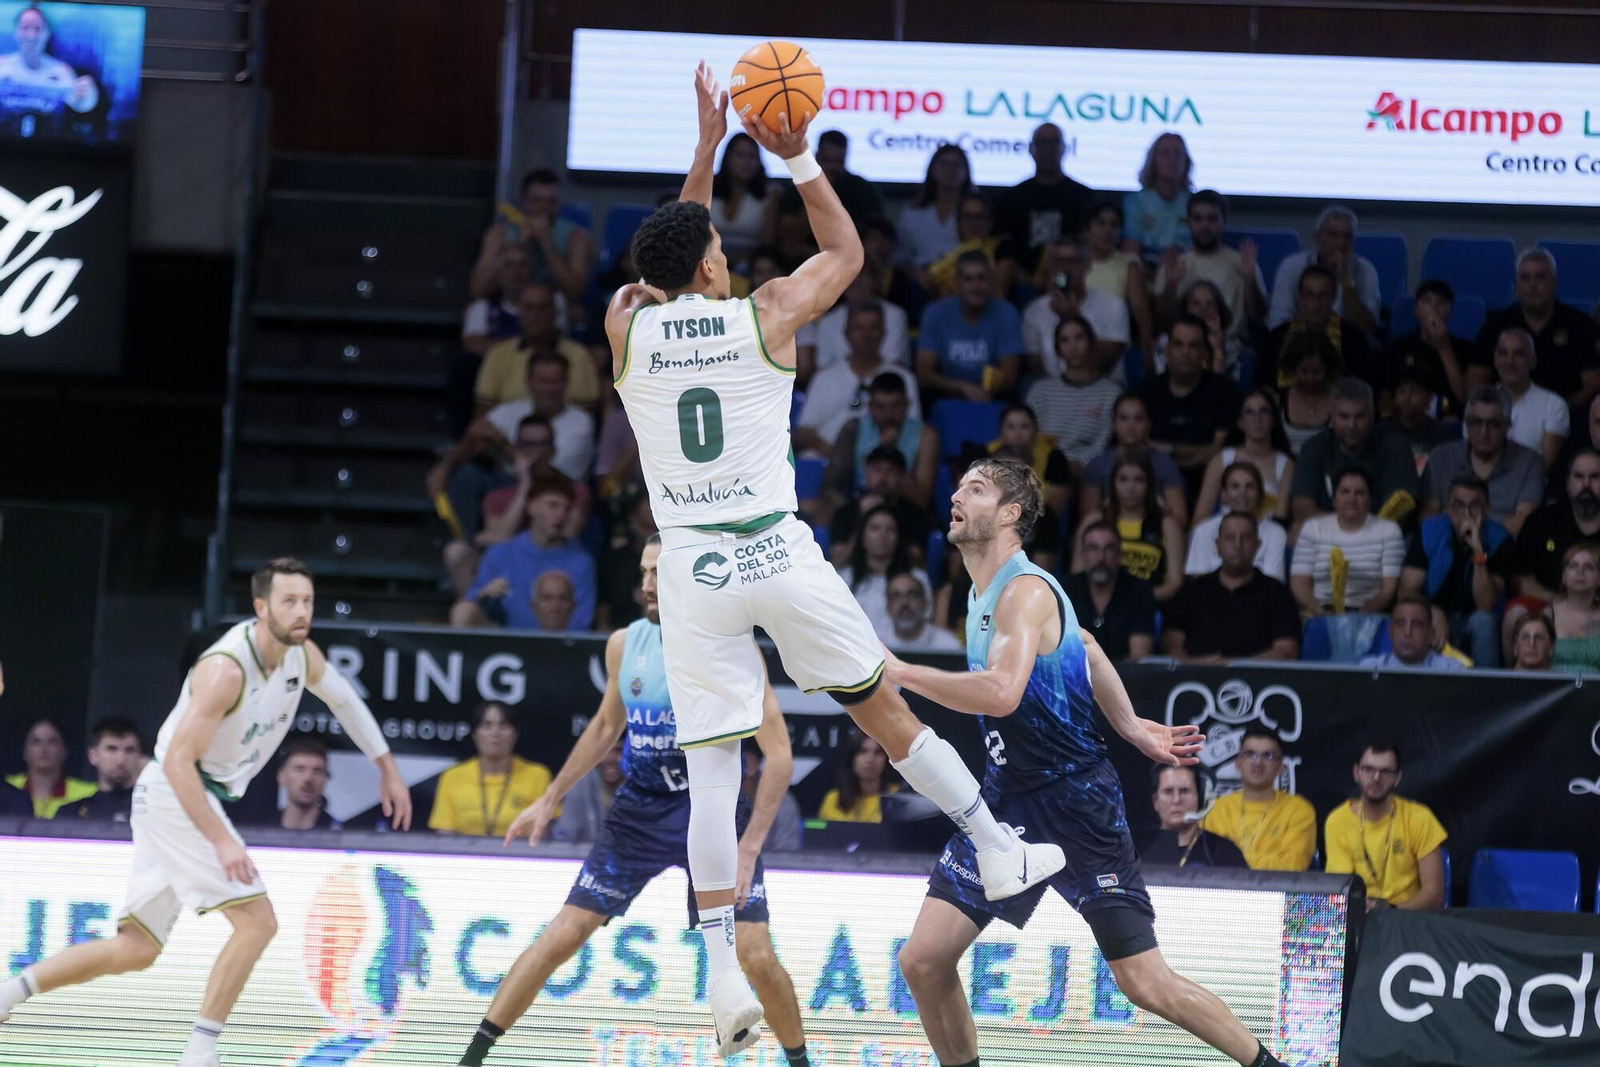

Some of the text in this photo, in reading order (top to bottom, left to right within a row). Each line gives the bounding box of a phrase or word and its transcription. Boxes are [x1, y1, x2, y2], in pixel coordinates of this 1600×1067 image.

[827, 87, 945, 121] ampo
[1365, 91, 1564, 143] Alcampo
[1486, 152, 1567, 174] Centro
[661, 316, 726, 340] TYSON
[677, 387, 725, 464] 0
[660, 478, 757, 507] Andalucía
[734, 533, 787, 560] COSTA
[736, 547, 790, 573] DEL SOL
[740, 560, 794, 585] MÁLAGA
[382, 717, 473, 743] GROUP
[724, 915, 735, 948] UNICAJA
[454, 915, 710, 1002] COST
[1379, 951, 1600, 1037] end
